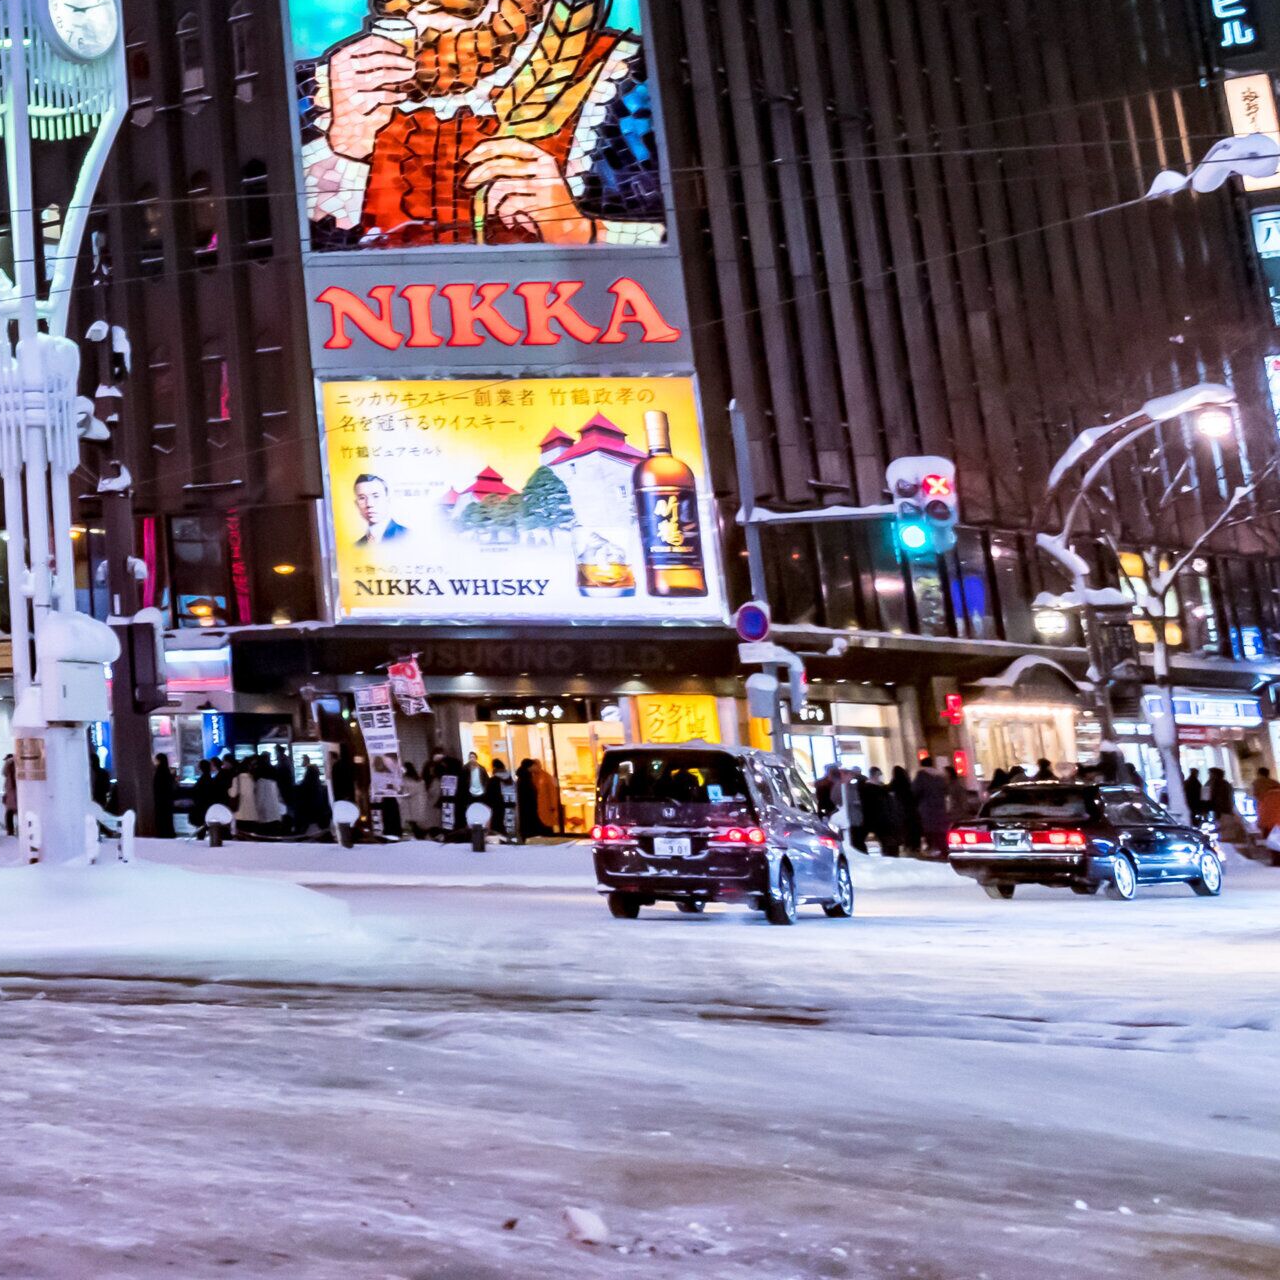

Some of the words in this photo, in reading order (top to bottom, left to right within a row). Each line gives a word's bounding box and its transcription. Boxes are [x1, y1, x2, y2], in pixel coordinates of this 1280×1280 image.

[316, 276, 682, 351] NIKKA
[354, 579, 445, 597] NIKKA
[448, 578, 550, 597] WHISKY
